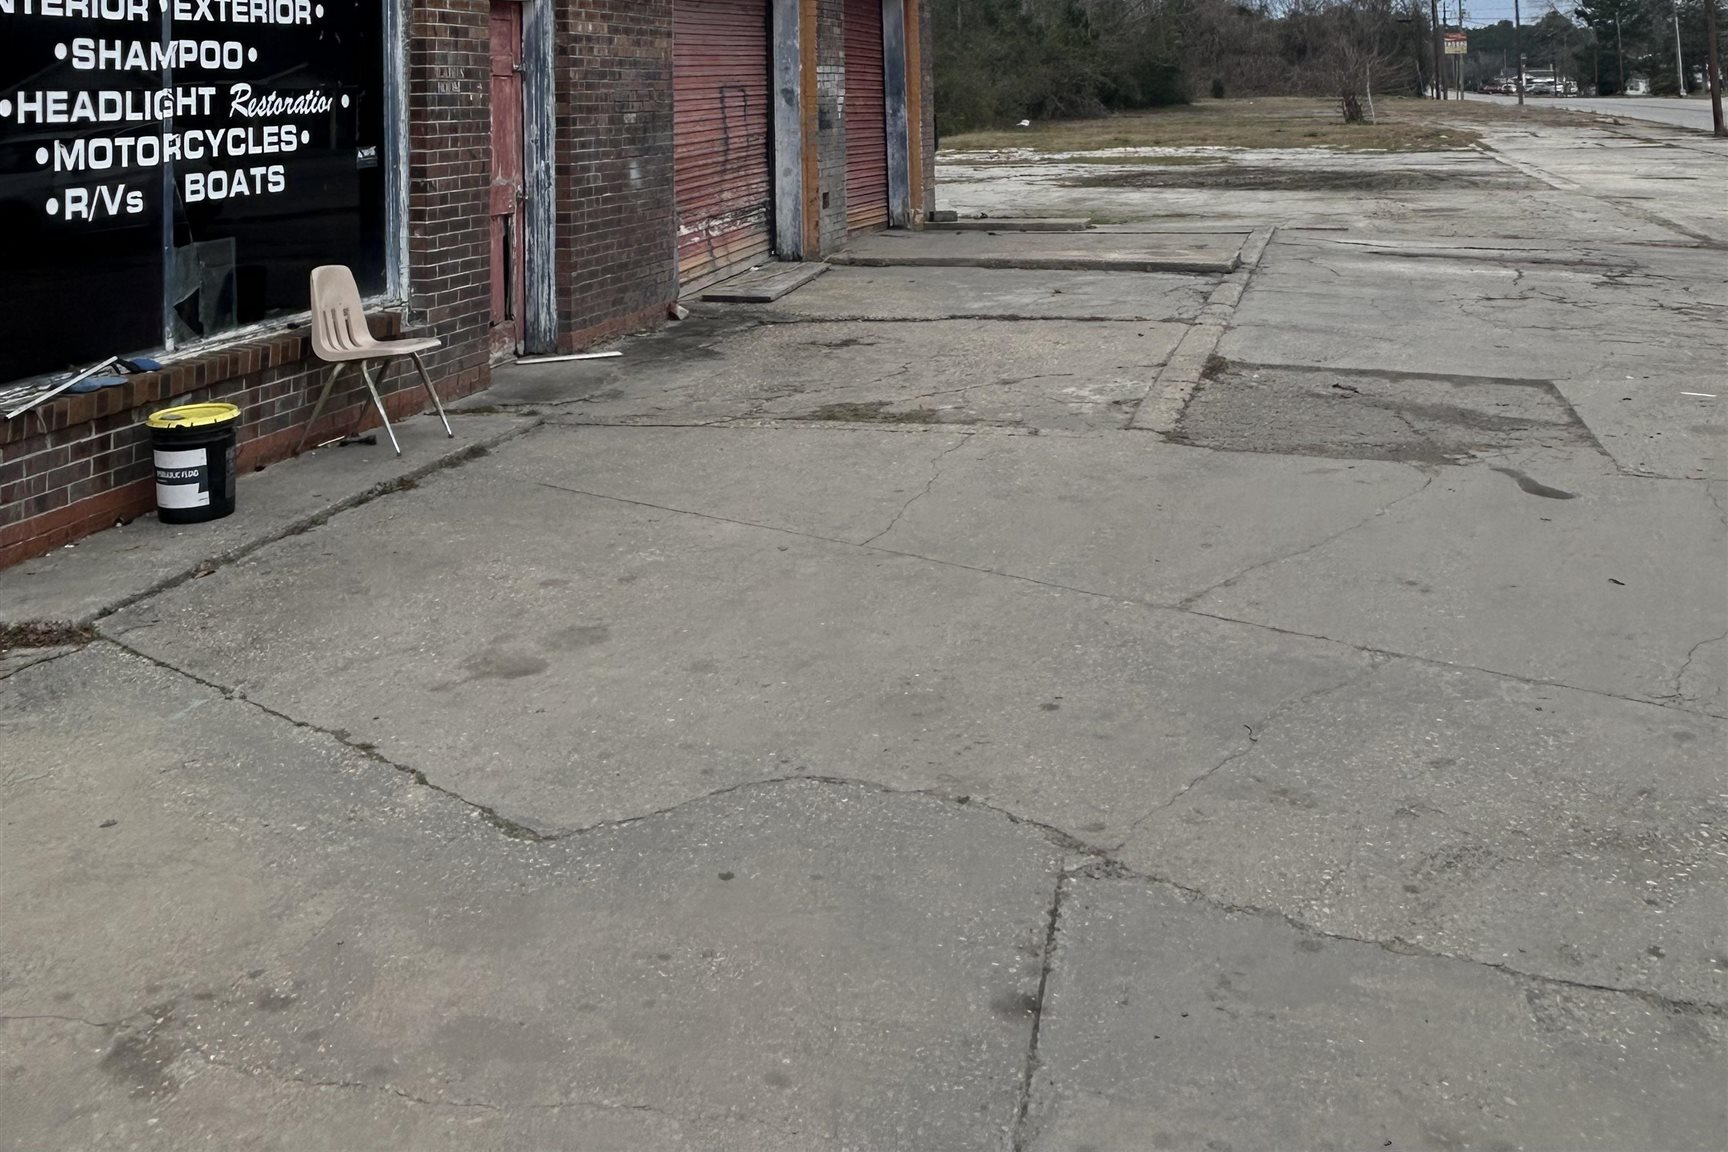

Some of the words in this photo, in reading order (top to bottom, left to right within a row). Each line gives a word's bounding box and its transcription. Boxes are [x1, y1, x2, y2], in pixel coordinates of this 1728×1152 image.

[72, 37, 244, 71] SHAMPOO
[17, 86, 216, 124] HEADLIGHT
[53, 124, 298, 172] MOTORCYCLES
[64, 183, 144, 222] R/Vs
[185, 164, 286, 203] BOATS
